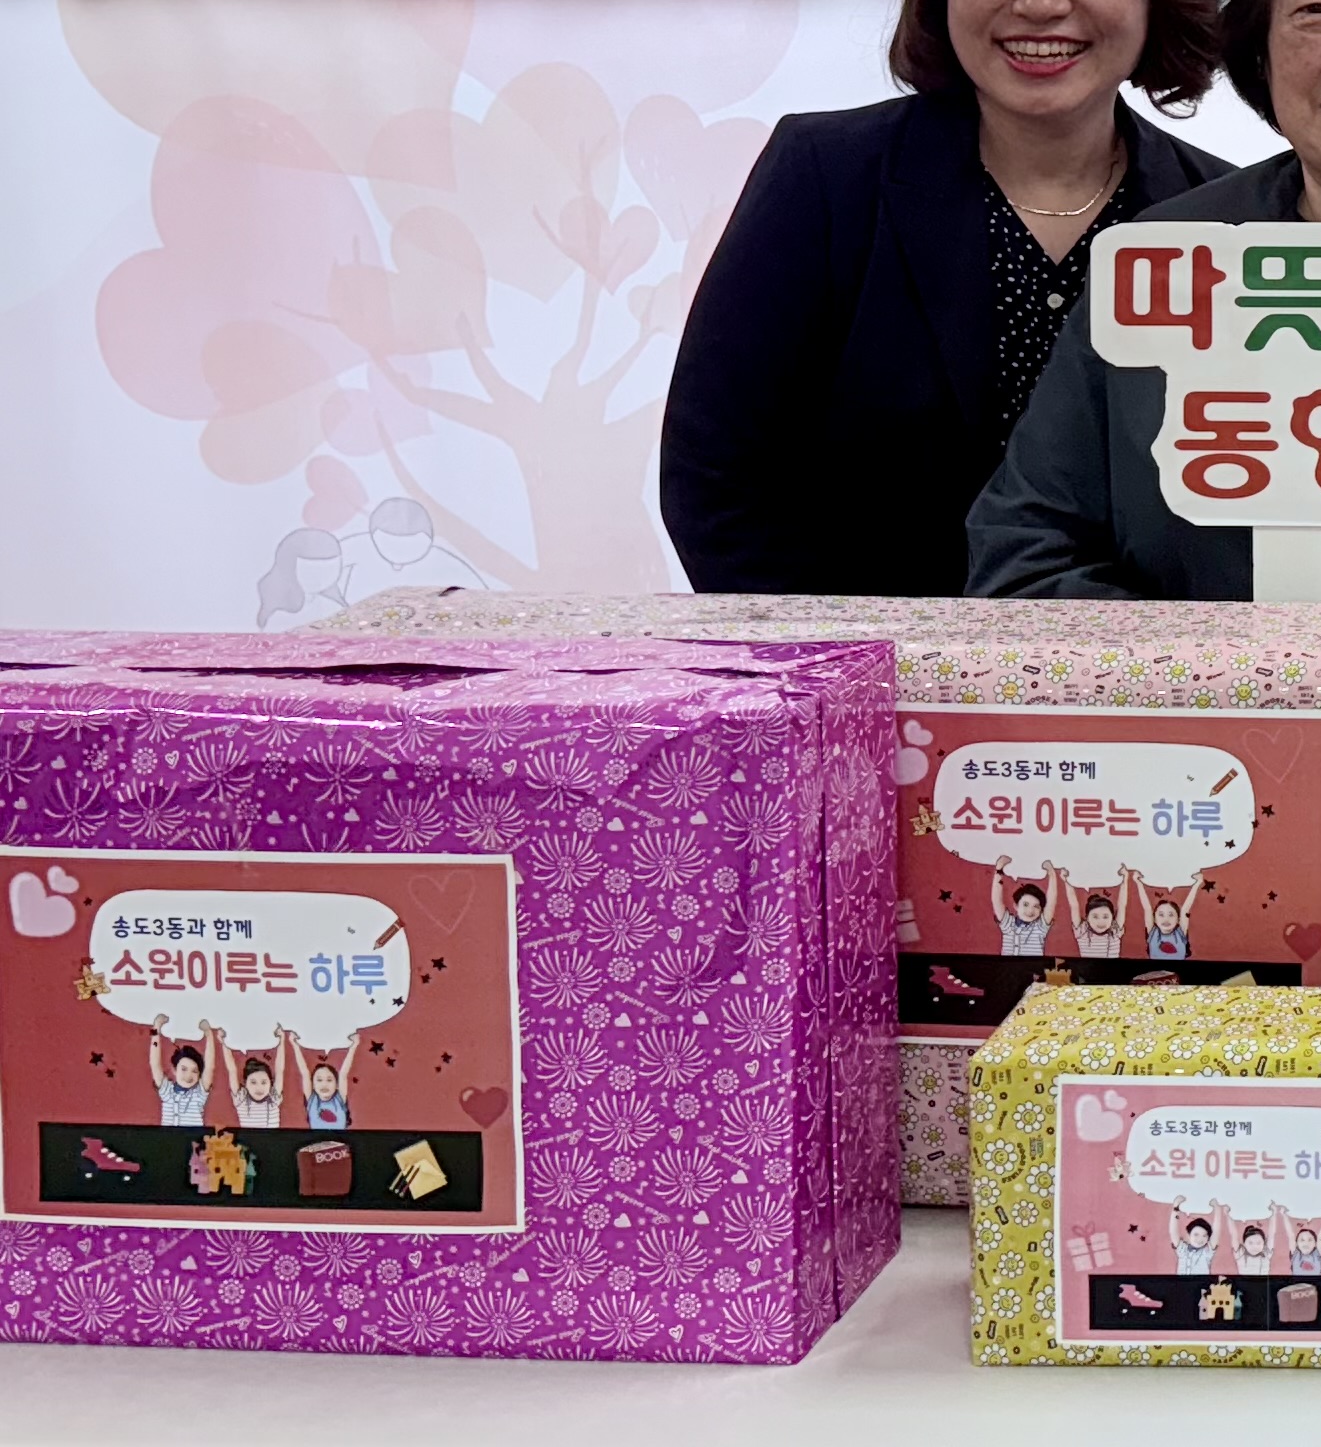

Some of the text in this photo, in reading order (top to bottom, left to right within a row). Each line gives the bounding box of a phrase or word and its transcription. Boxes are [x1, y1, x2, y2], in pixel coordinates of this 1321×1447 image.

[962, 759, 1096, 781] 송도3동과 함께
[950, 796, 1223, 838] 소원 이루는 하루
[112, 917, 252, 940] 송도3동과 함께
[110, 949, 388, 995] 소원이루는 하루
[1149, 1120, 1252, 1137] 송도3동과 함께
[315, 1149, 350, 1164] BOOK
[1139, 1149, 1196, 1179] 소원
[1205, 1149, 1286, 1180] 이루는
